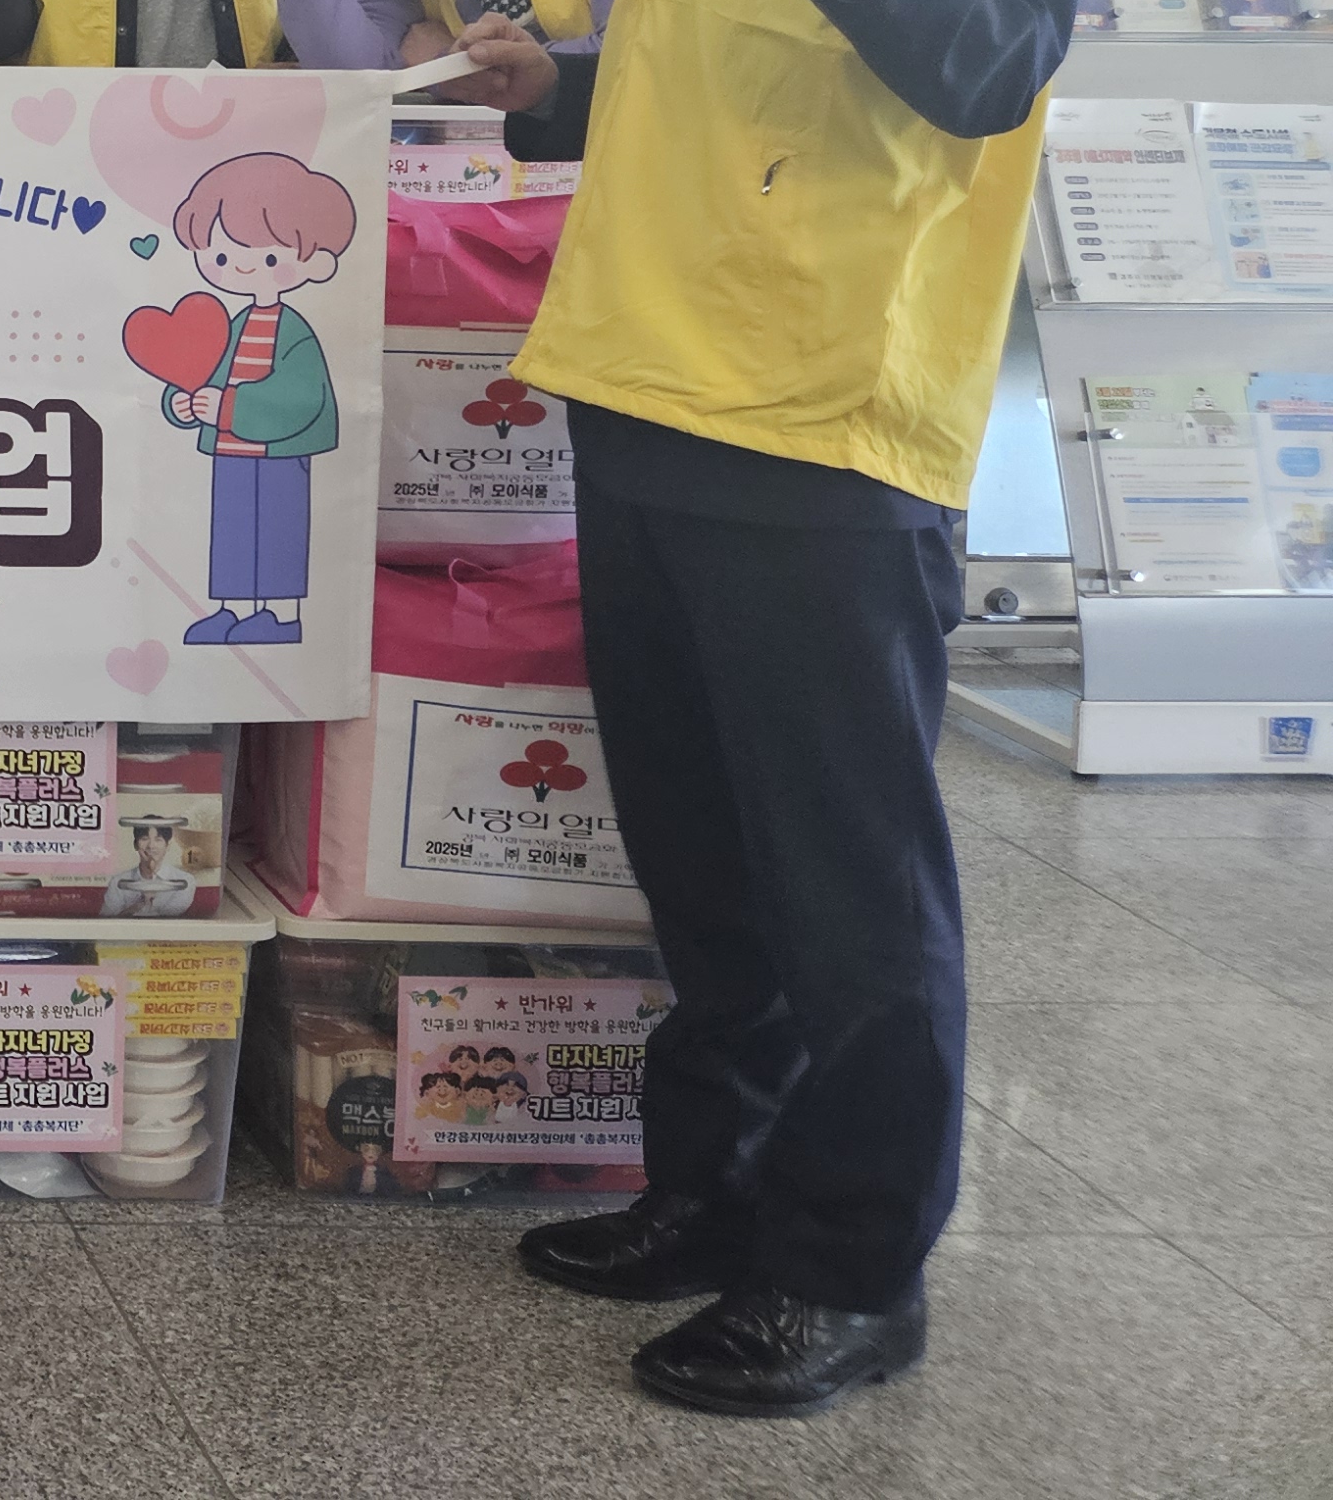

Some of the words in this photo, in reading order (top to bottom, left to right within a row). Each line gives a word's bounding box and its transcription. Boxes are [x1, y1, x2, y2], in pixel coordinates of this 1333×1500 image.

[407, 445, 513, 472] 사랑의
[393, 482, 440, 496] 2025년
[491, 484, 547, 499] 모이식품
[30, 724, 94, 741] 응원합니다!
[4, 803, 50, 828] 지원
[54, 804, 100, 830] 사업
[443, 805, 548, 833] 사랑의
[425, 840, 473, 859] 2025년
[527, 849, 587, 868] 모이식품
[0, 1004, 35, 1019] 방학을
[40, 1004, 102, 1020] 응원합니다!
[144, 1003, 195, 1014] 쇠고기카레
[518, 995, 573, 1016] 반가워
[140, 1023, 190, 1035] 쇠고기카레
[421, 1018, 468, 1032] 친구들의
[473, 1018, 520, 1033] 활기차고
[525, 1019, 560, 1034] 건강한
[565, 1020, 601, 1034] 방학을
[14, 1083, 59, 1107] 지원
[63, 1083, 109, 1108] 사업
[528, 1096, 574, 1120] 키트
[577, 1097, 623, 1121] 지원
